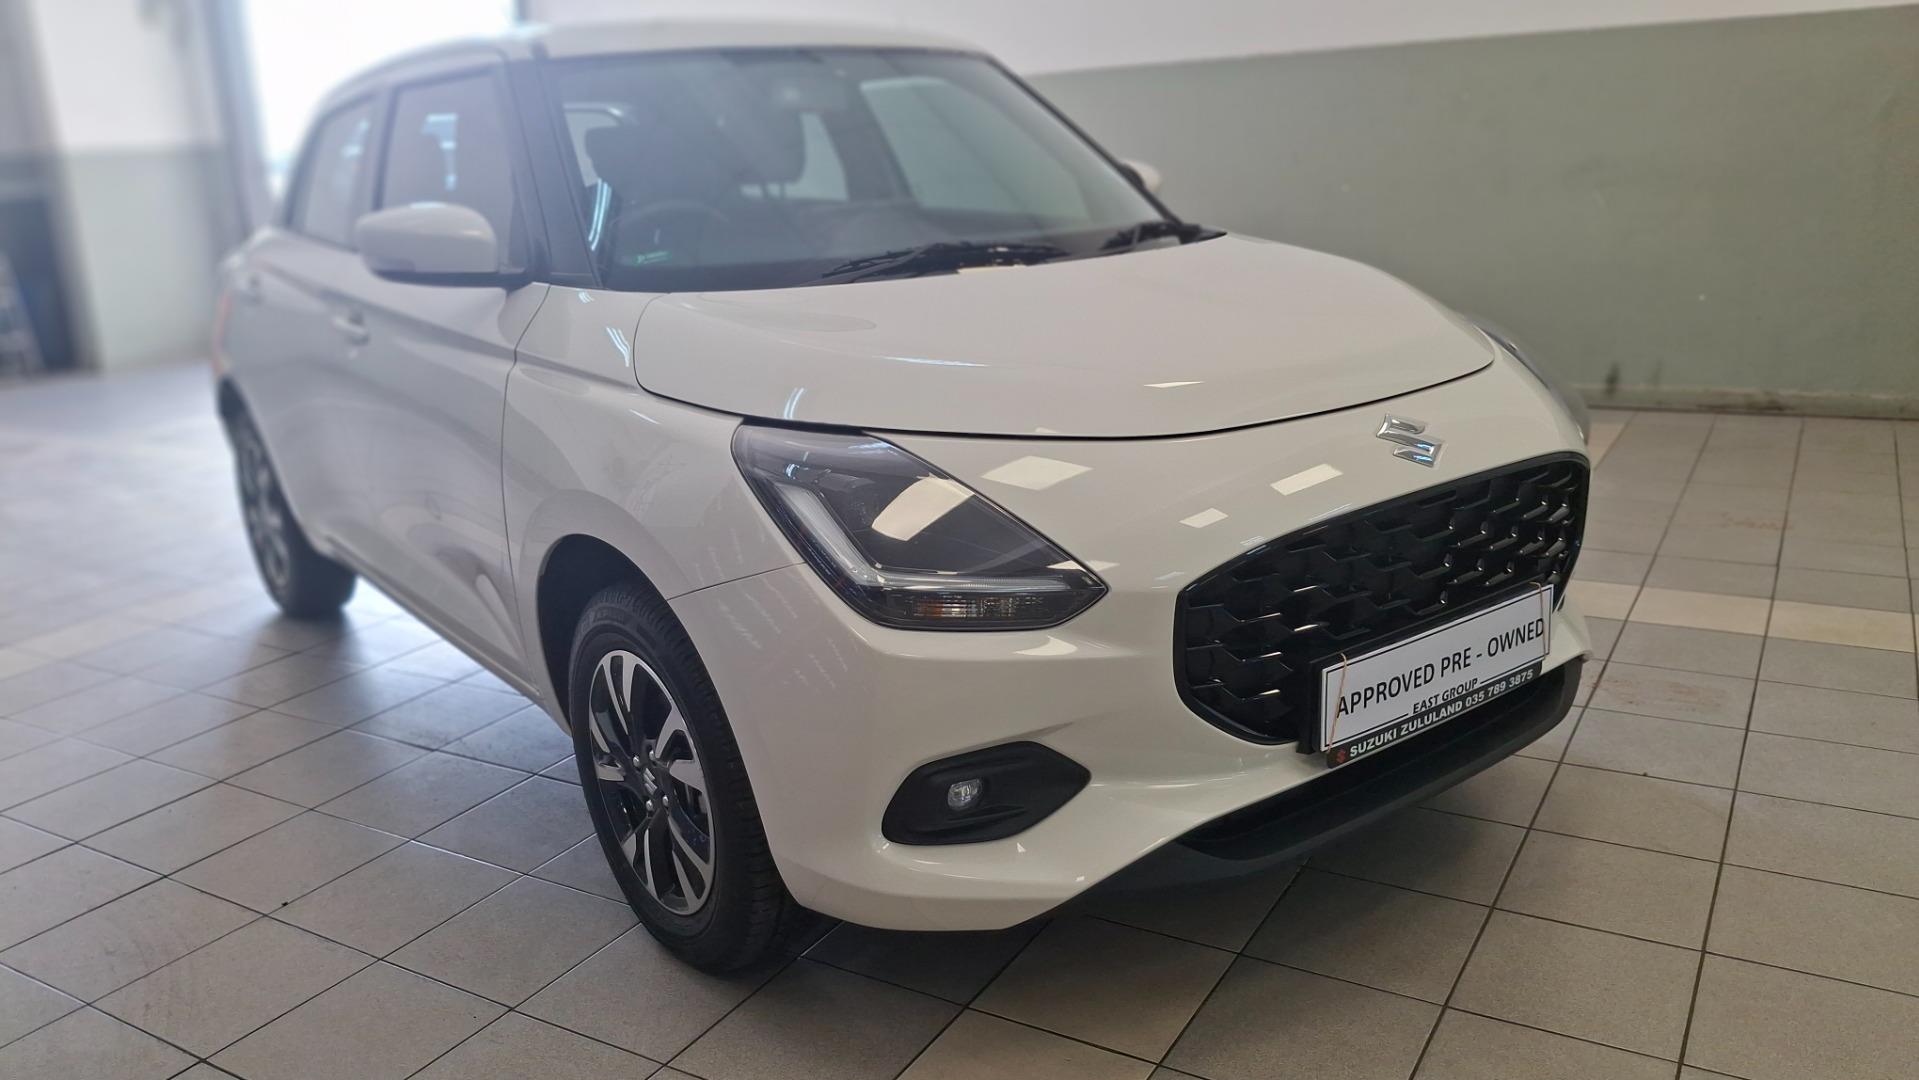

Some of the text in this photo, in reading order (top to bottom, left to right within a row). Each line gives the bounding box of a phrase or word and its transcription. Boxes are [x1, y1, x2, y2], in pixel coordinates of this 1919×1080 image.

[1336, 663, 1435, 719] APPROVED
[1440, 646, 1472, 678] PRE
[1487, 618, 1544, 657] OWNED
[1412, 678, 1478, 714] EAST GROUP
[1349, 669, 1534, 757] SUZUKI ZULULAND 035 789 3875
